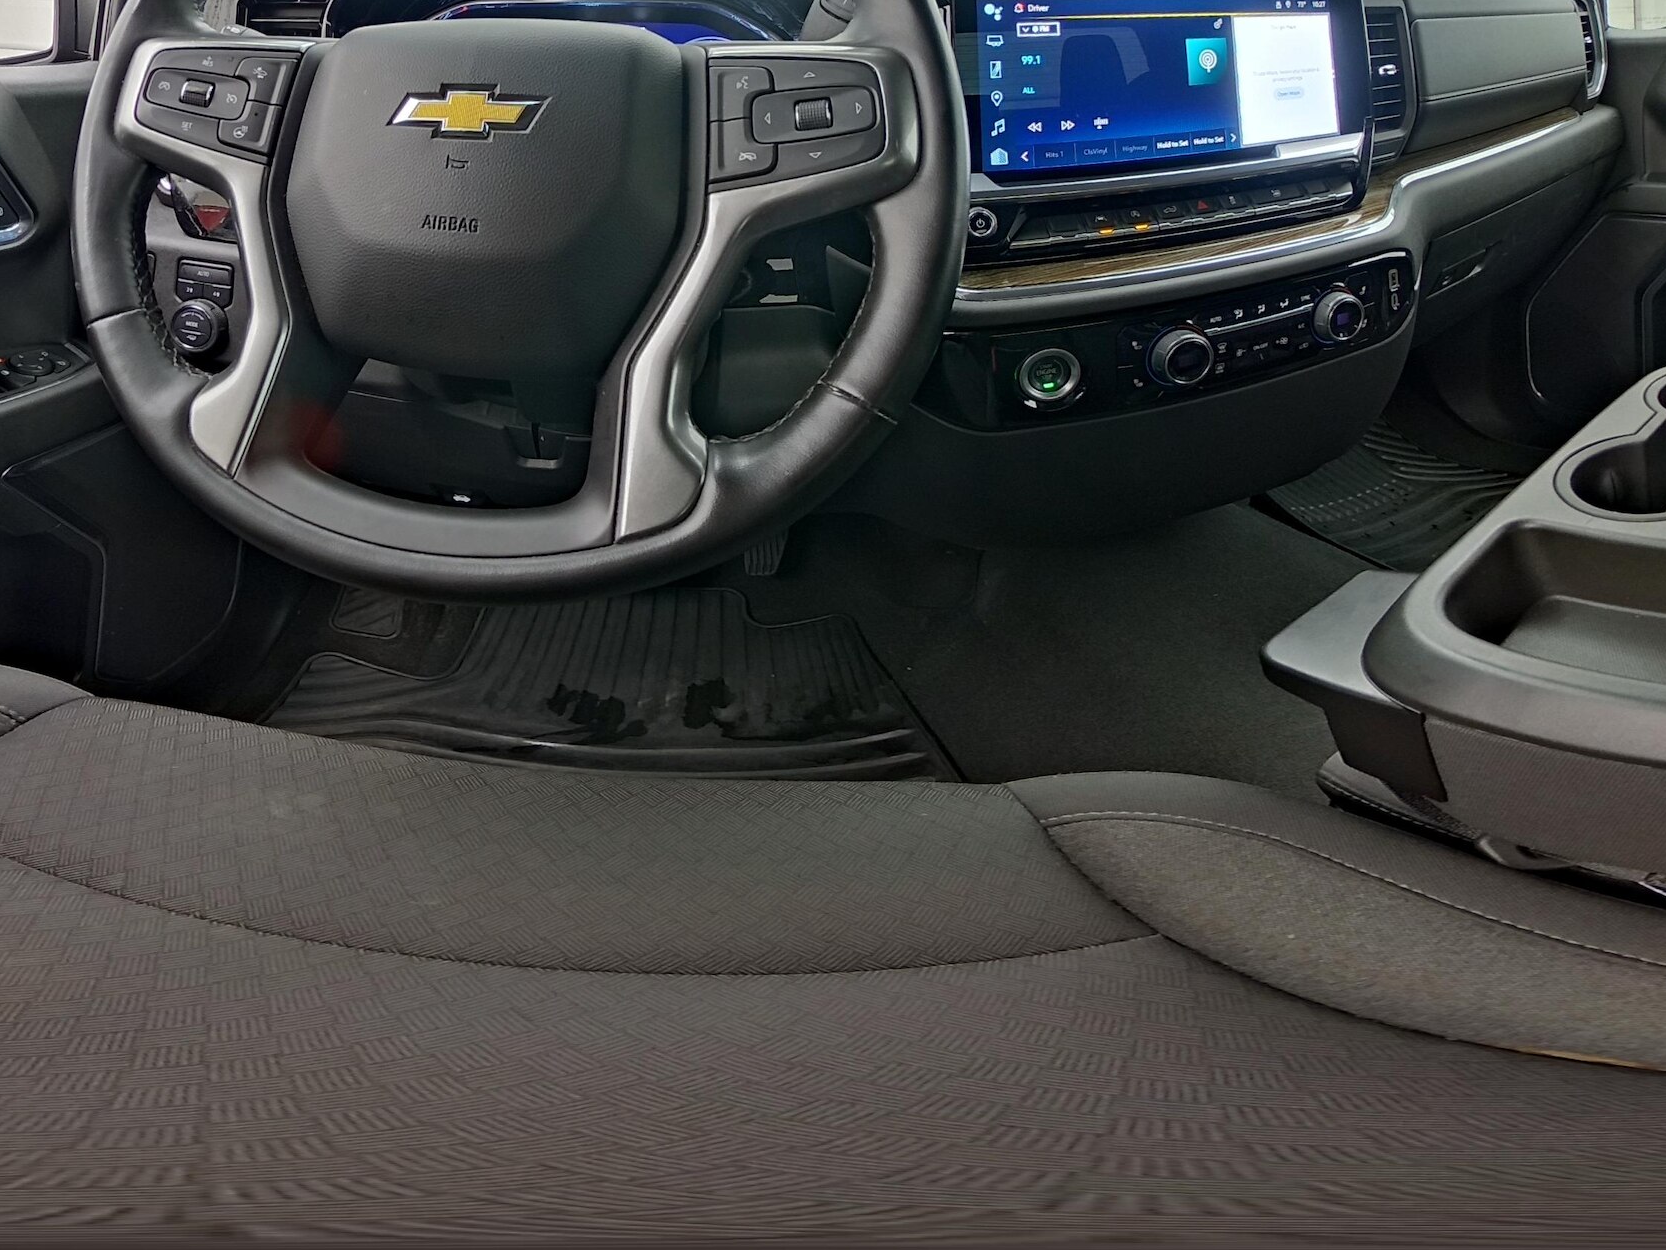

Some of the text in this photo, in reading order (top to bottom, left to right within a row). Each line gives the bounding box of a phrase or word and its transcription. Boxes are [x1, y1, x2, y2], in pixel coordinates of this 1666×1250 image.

[1027, 4, 1050, 13] Driver
[1021, 55, 1041, 65] 99.1
[1157, 140, 1171, 149] Hold
[1178, 139, 1189, 147] Set
[1193, 136, 1208, 145] Hold
[1214, 135, 1225, 143] Set
[1122, 144, 1148, 153] Highway
[1045, 151, 1059, 159] Hits
[420, 214, 479, 234] AIRBAG
